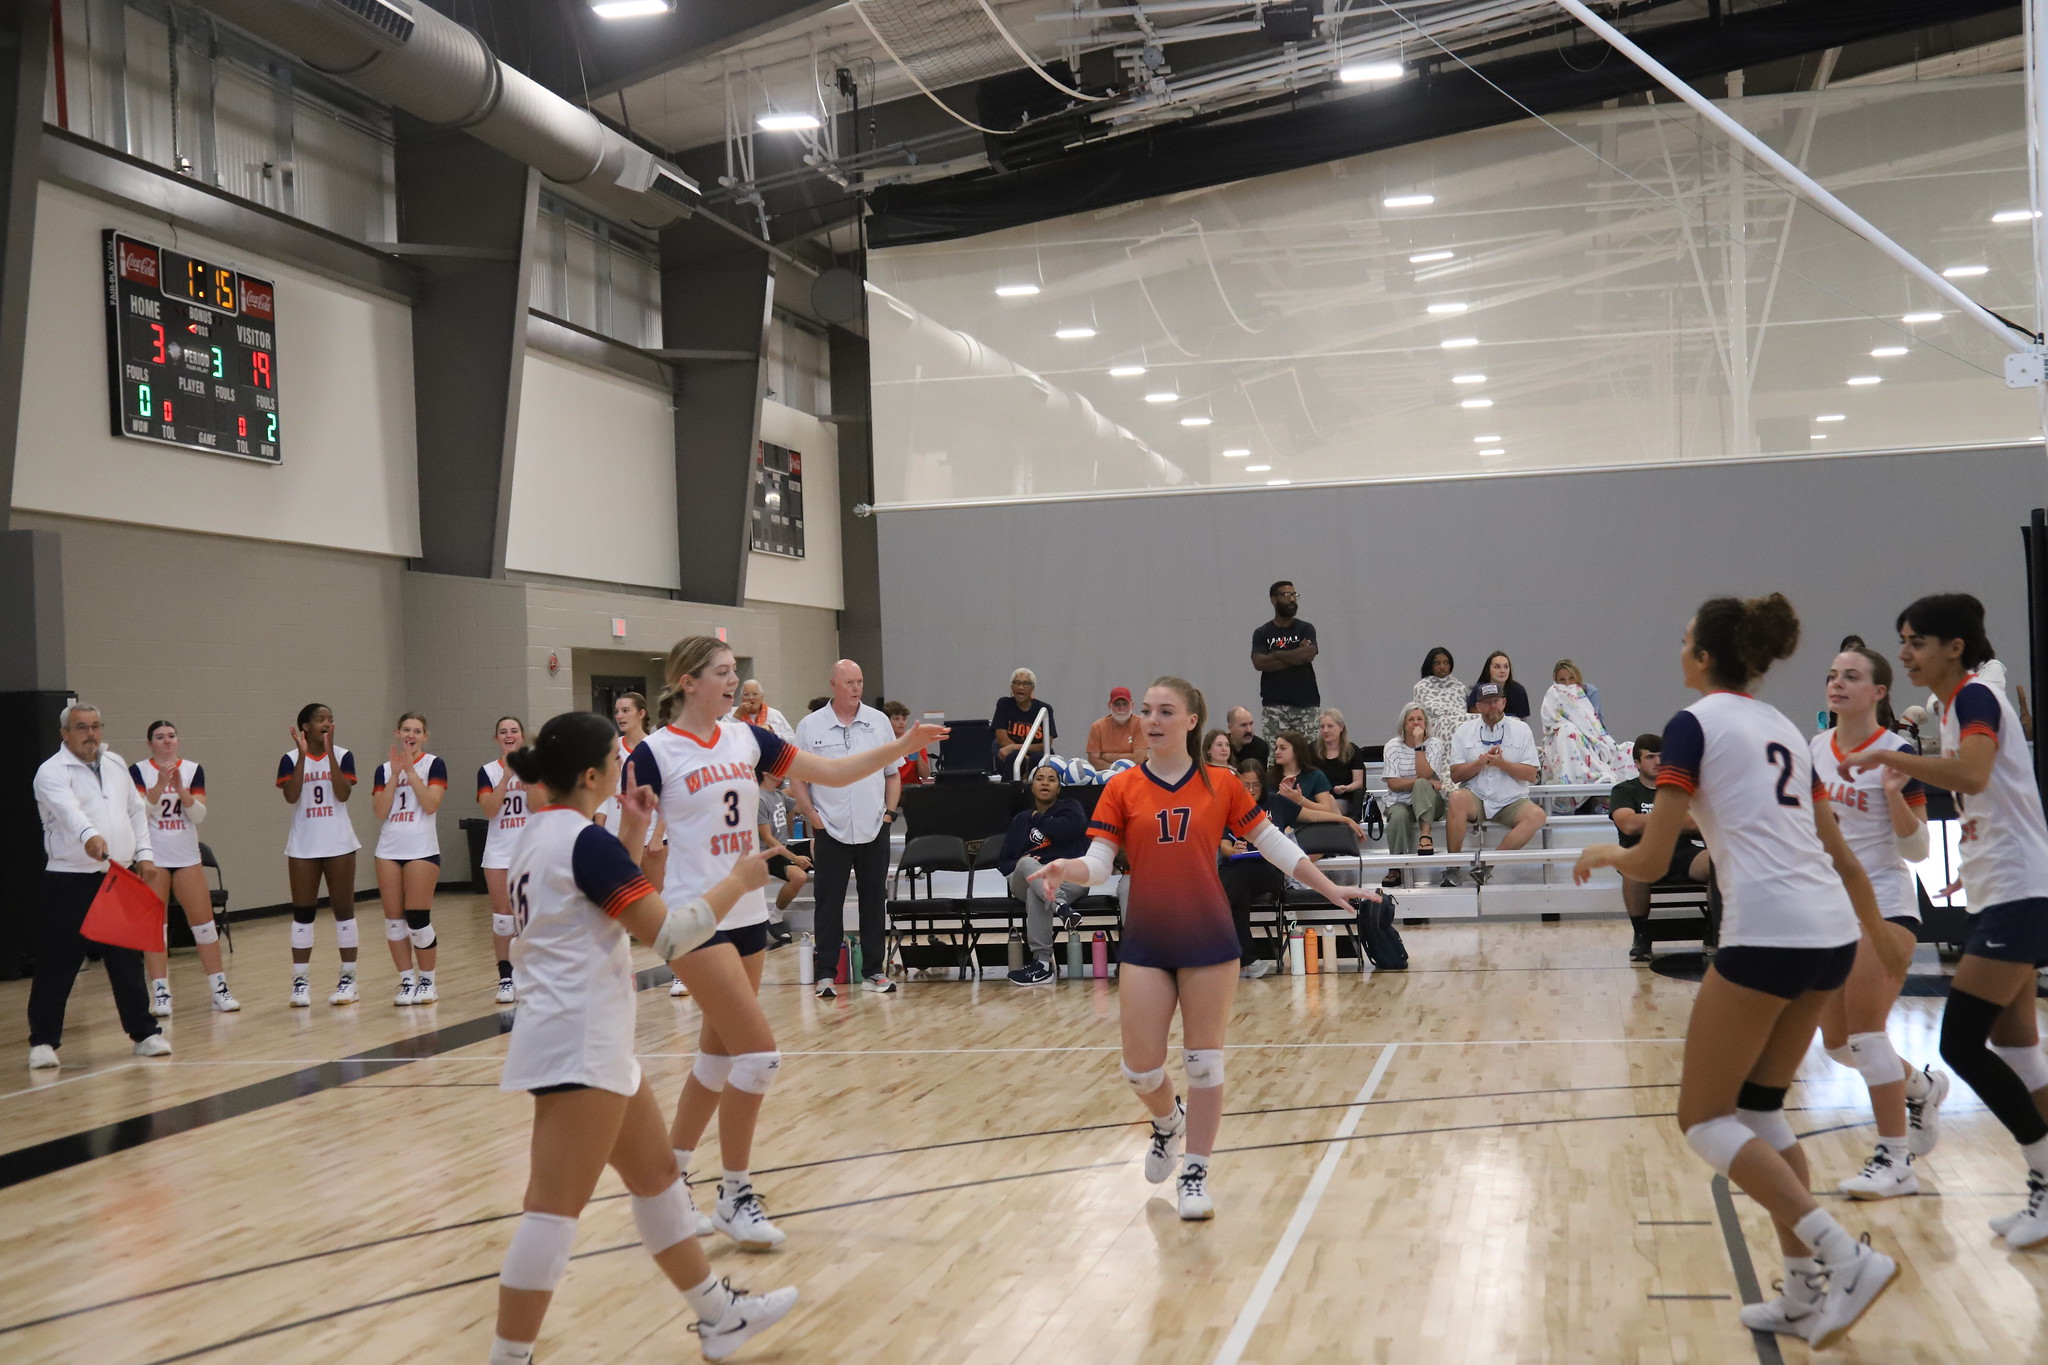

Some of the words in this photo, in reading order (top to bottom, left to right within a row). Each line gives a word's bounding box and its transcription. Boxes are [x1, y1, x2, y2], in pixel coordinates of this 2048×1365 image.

[127, 252, 156, 278] Coca-Cola
[187, 260, 233, 310] 1:15
[130, 294, 161, 320] HOME
[246, 289, 272, 313] Coca-Cola
[189, 306, 213, 325] BONUS
[150, 323, 166, 364] 3
[236, 325, 272, 350] VISITOR
[183, 348, 210, 367] PERIOD
[211, 346, 223, 378] 3
[126, 364, 149, 382] FOULS
[252, 351, 271, 389] 19
[178, 376, 205, 395] PLAYER
[215, 385, 236, 402] FOULS
[138, 384, 152, 417] 0
[163, 400, 173, 422] 0
[256, 394, 275, 411] FOULS
[132, 419, 149, 433] WON
[161, 424, 176, 440] TOL
[238, 416, 247, 437] 0
[266, 412, 277, 443] 2
[198, 431, 216, 446] GAME
[236, 439, 250, 454] TOL
[304, 770, 332, 783] ALLAC
[1766, 741, 1801, 809] 2
[313, 785, 324, 805] 9
[399, 791, 406, 811] 1
[503, 795, 523, 816] 20
[1828, 781, 1869, 813] LACE
[161, 798, 183, 818] 24
[305, 806, 334, 818] STATE
[390, 811, 415, 823] STATE
[723, 788, 740, 828] 3
[158, 819, 187, 831] STATE
[1155, 806, 1192, 845] 17
[710, 829, 753, 856] STATE
